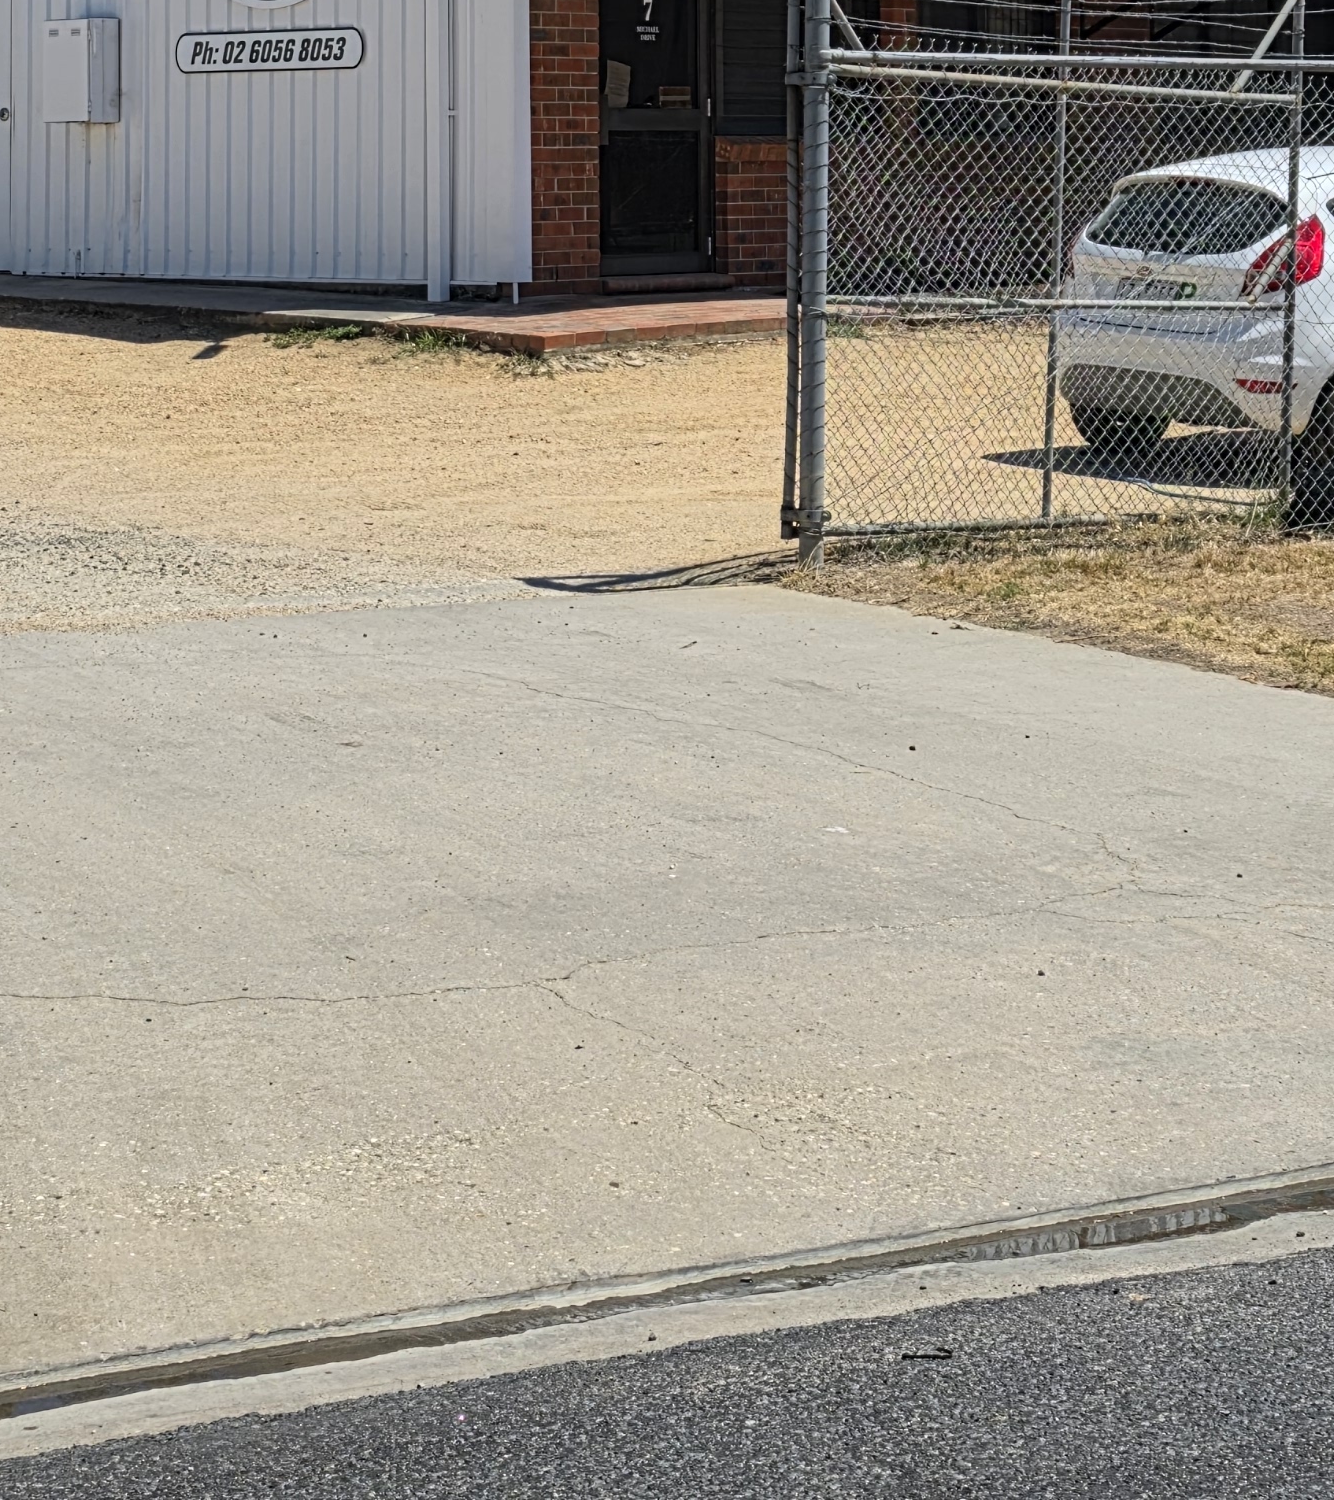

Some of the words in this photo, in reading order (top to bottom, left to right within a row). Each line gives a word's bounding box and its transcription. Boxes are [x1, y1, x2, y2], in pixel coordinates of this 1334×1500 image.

[190, 41, 219, 65] Ph:
[222, 40, 246, 64] 02
[249, 38, 296, 63] 6056
[298, 36, 347, 62] 8053
